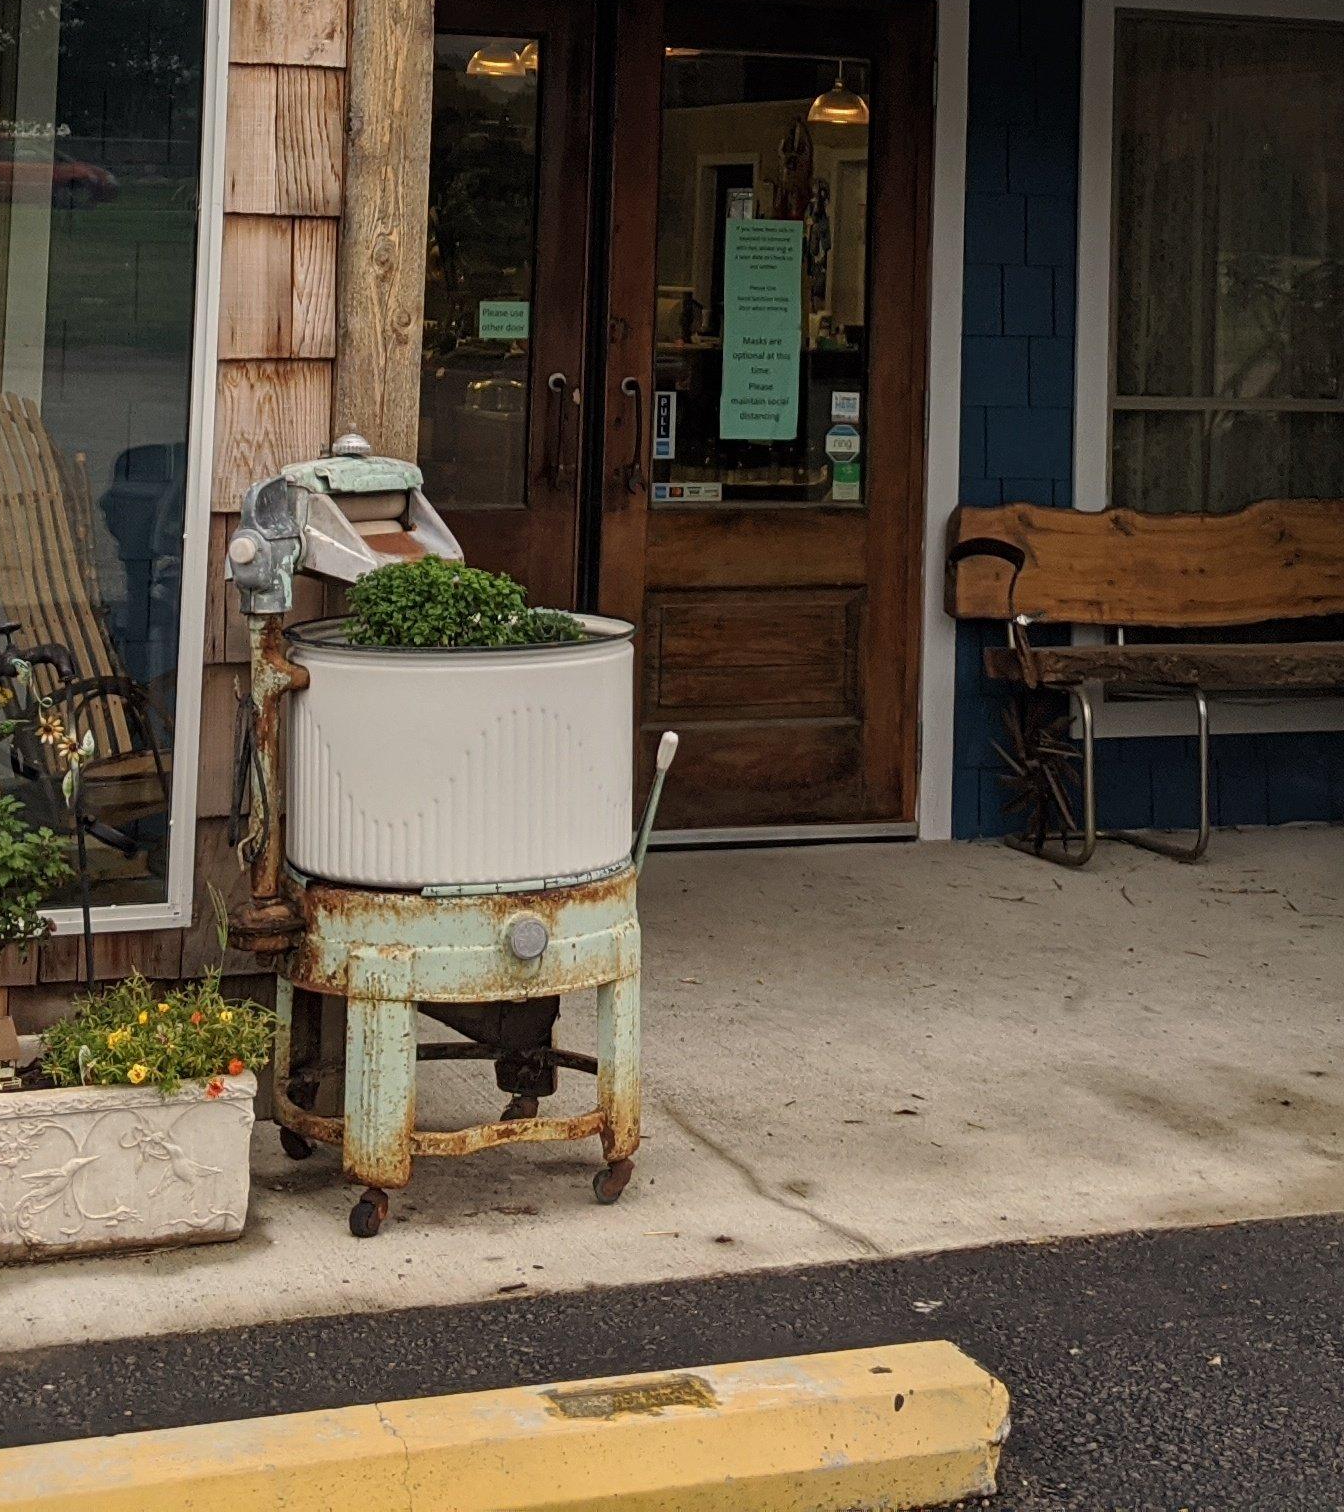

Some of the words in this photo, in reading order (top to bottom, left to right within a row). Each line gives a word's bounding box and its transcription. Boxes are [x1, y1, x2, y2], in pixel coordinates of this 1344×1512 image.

[483, 308, 507, 317] Please
[482, 323, 503, 331] other
[506, 323, 524, 331] door
[743, 337, 767, 345] Masks
[733, 352, 764, 362] optional
[767, 352, 775, 360] at
[777, 352, 790, 360] this
[749, 382, 774, 390] Please
[731, 397, 766, 406] maintain
[768, 396, 789, 406] social
[660, 397, 668, 436] PULL
[739, 412, 780, 423] distancing
[834, 438, 852, 450] ring
